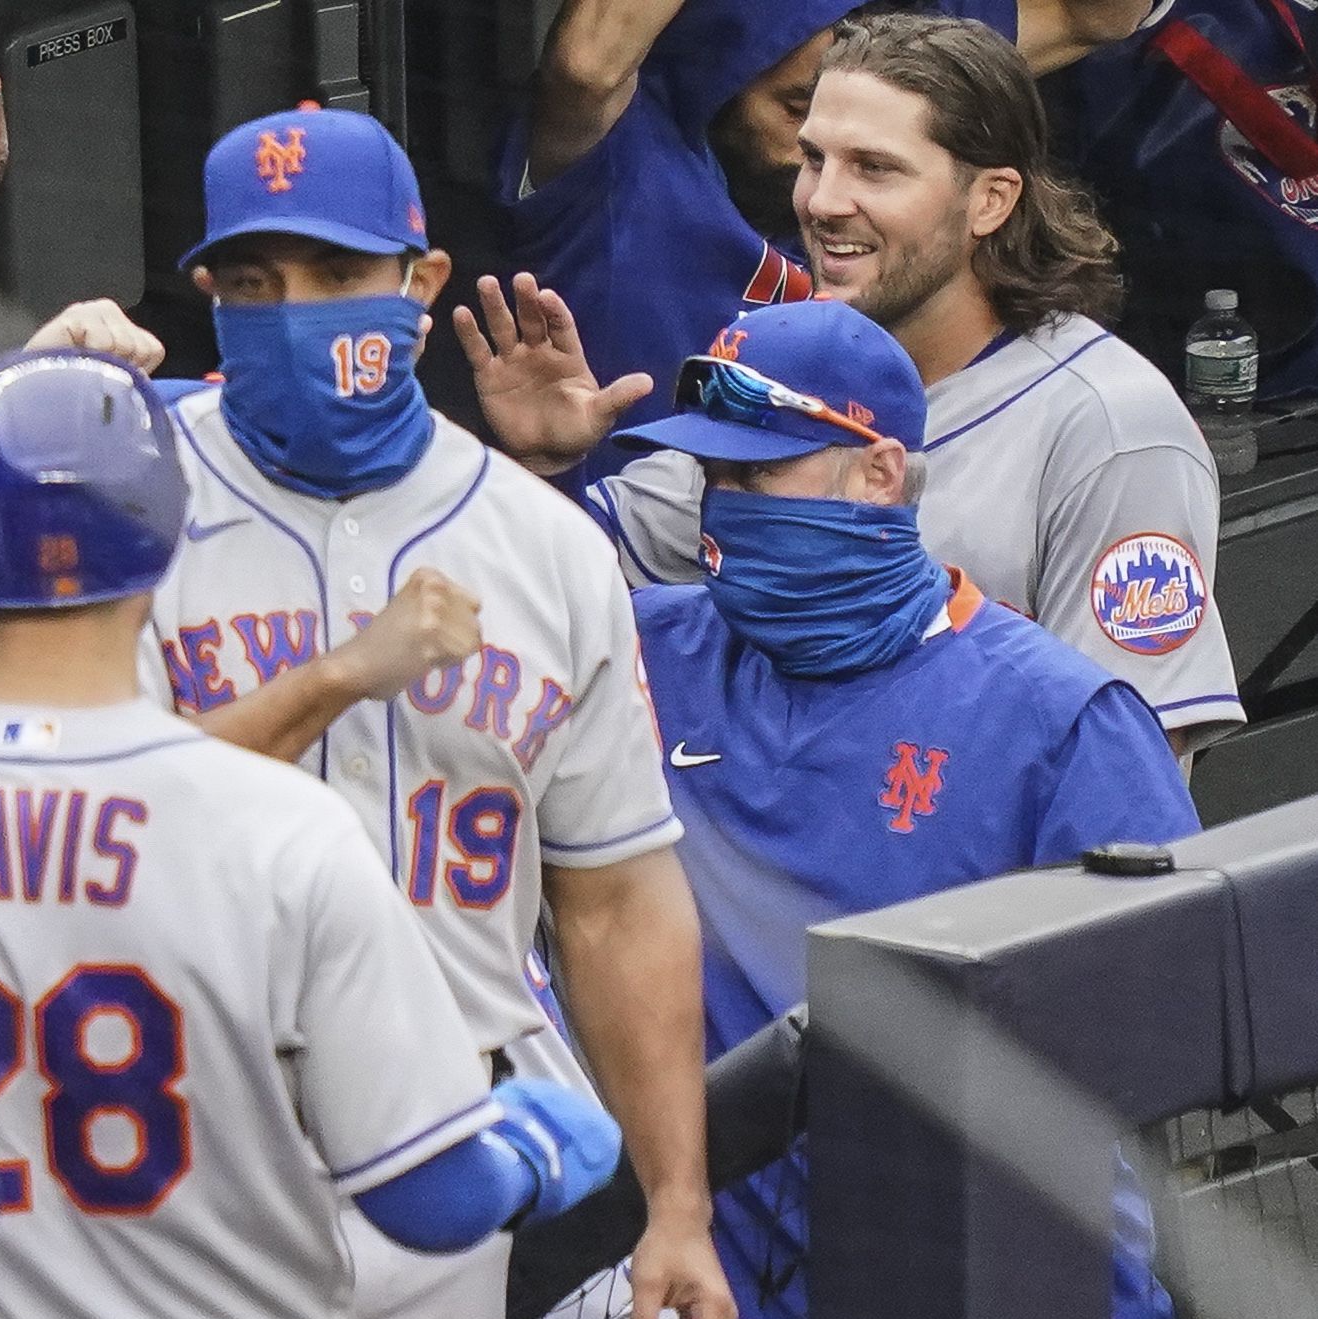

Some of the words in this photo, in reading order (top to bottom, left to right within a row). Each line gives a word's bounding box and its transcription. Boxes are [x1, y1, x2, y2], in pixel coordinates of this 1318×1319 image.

[39, 33, 81, 61] PRESS
[87, 24, 114, 48] BOX
[329, 333, 392, 399] 19
[1110, 577, 1191, 625] Mets
[349, 612, 573, 774] ORK
[879, 741, 950, 835] NY
[408, 779, 523, 911] 19
